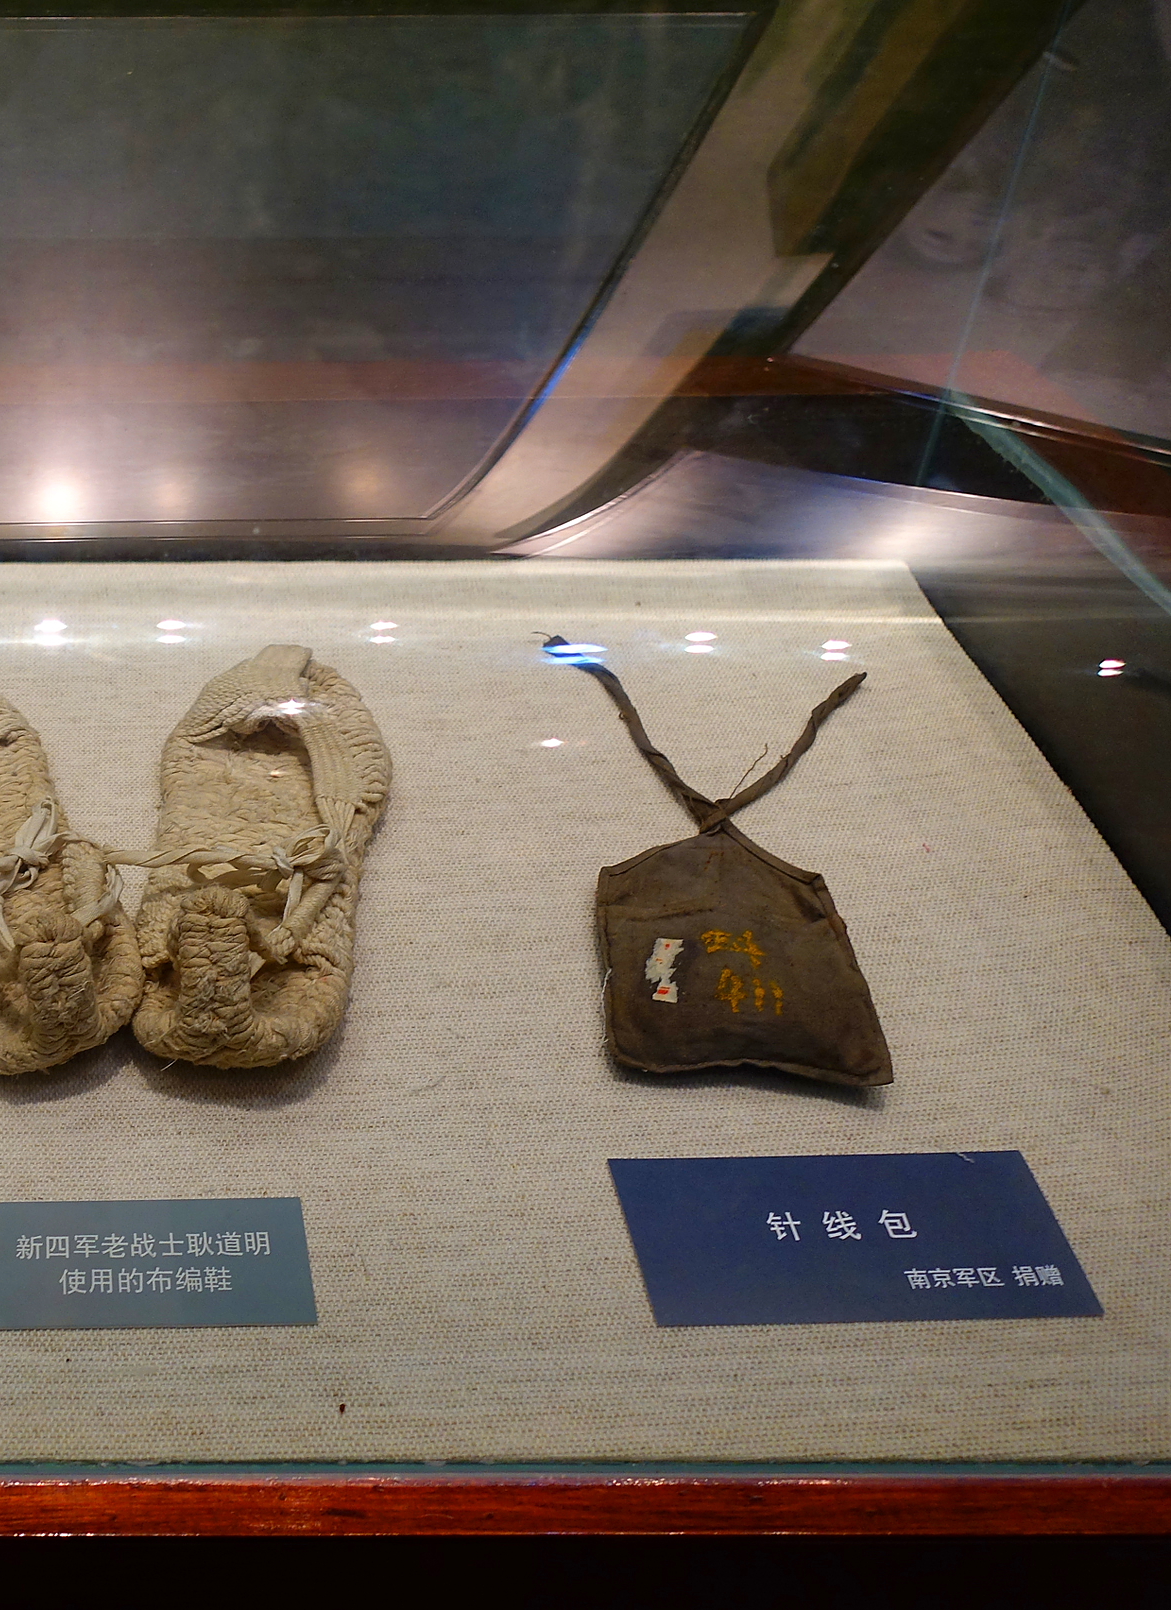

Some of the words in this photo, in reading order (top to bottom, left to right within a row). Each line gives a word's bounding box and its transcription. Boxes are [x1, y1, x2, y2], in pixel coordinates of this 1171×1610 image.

[15, 1230, 272, 1260] 新四军老战士耿道明
[58, 1265, 233, 1294] 使用的布编鞋
[903, 1265, 1006, 1289] 南京军区
[1011, 1264, 1065, 1287] 捐赠
